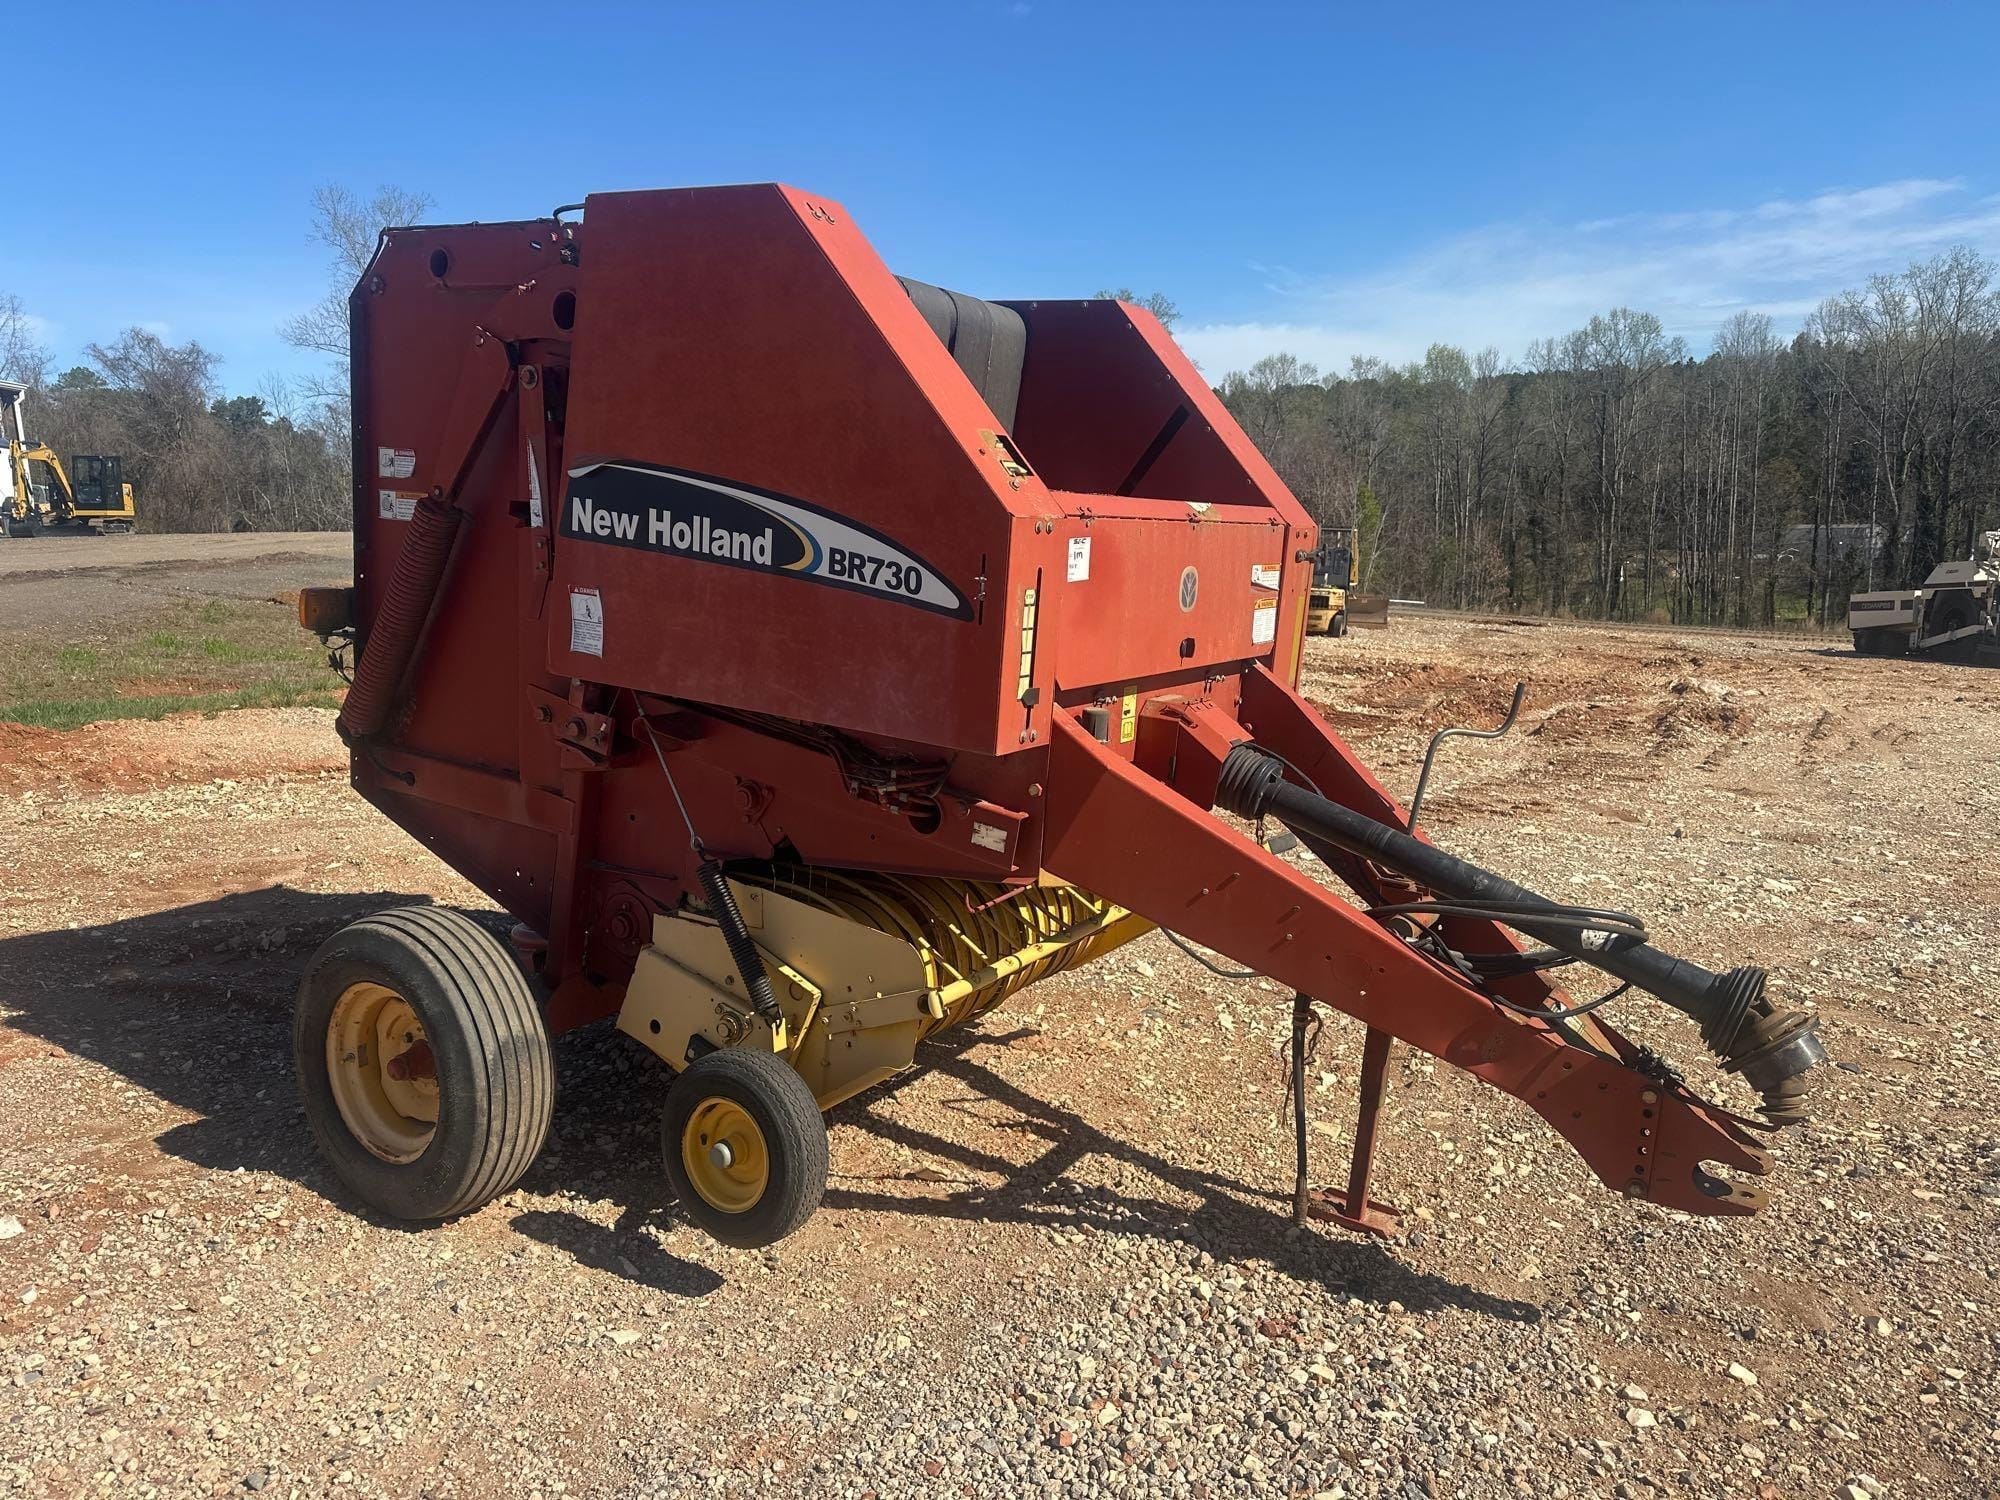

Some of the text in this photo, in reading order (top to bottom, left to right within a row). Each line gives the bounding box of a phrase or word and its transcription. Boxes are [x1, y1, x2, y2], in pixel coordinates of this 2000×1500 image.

[571, 497, 773, 566] New Holland
[828, 546, 922, 596] BR730
